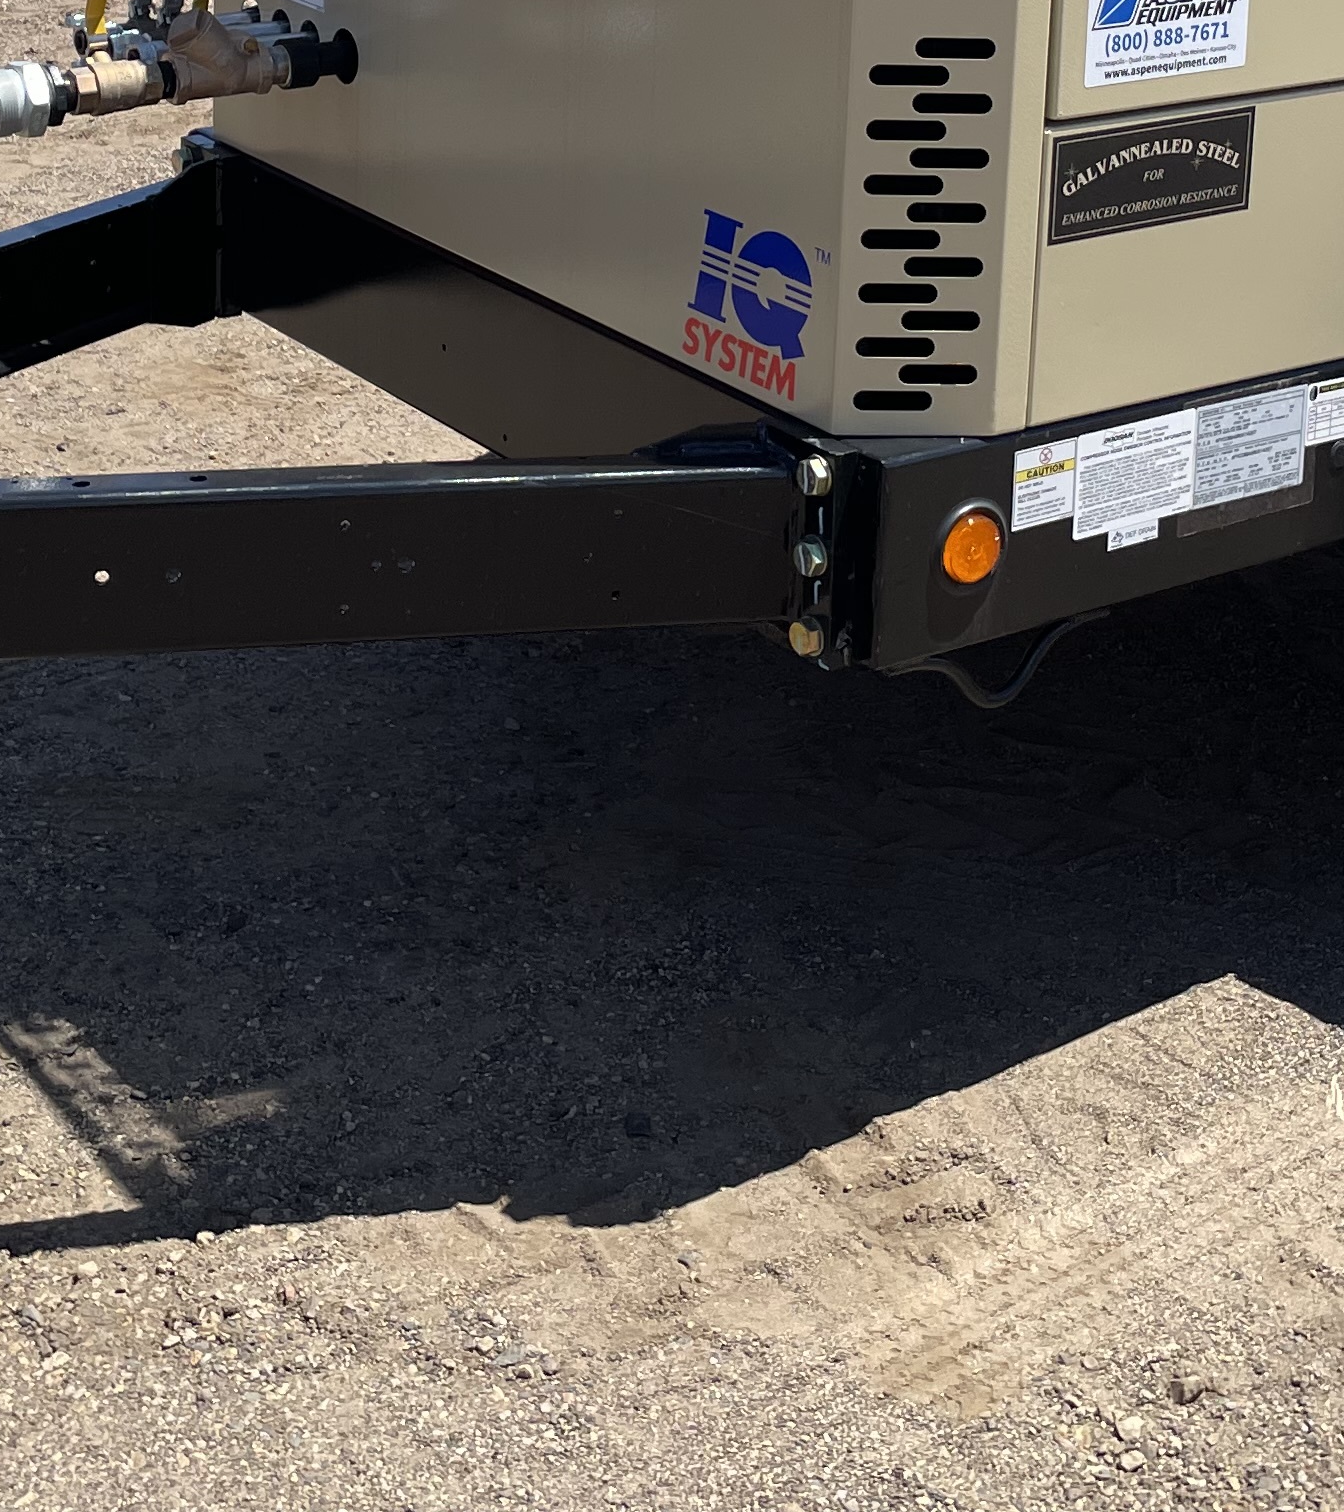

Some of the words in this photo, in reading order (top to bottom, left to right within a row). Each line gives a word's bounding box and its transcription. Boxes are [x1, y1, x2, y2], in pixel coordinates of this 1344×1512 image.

[1105, 29, 1149, 58] (800)
[1153, 21, 1229, 47] 888-7671
[1104, 54, 1227, 79] www.aspenequipment.com
[1062, 138, 1193, 197] GALVANNEALED
[1196, 140, 1241, 169] STEEL
[1143, 169, 1165, 183] FOR
[1061, 205, 1119, 226] ENHANCED
[1120, 194, 1179, 215] CORROSION
[1179, 184, 1239, 205] RESISTANCE
[687, 208, 812, 360] IQ
[682, 317, 796, 402] SYSTEM
[1027, 463, 1065, 479] CAUTION
